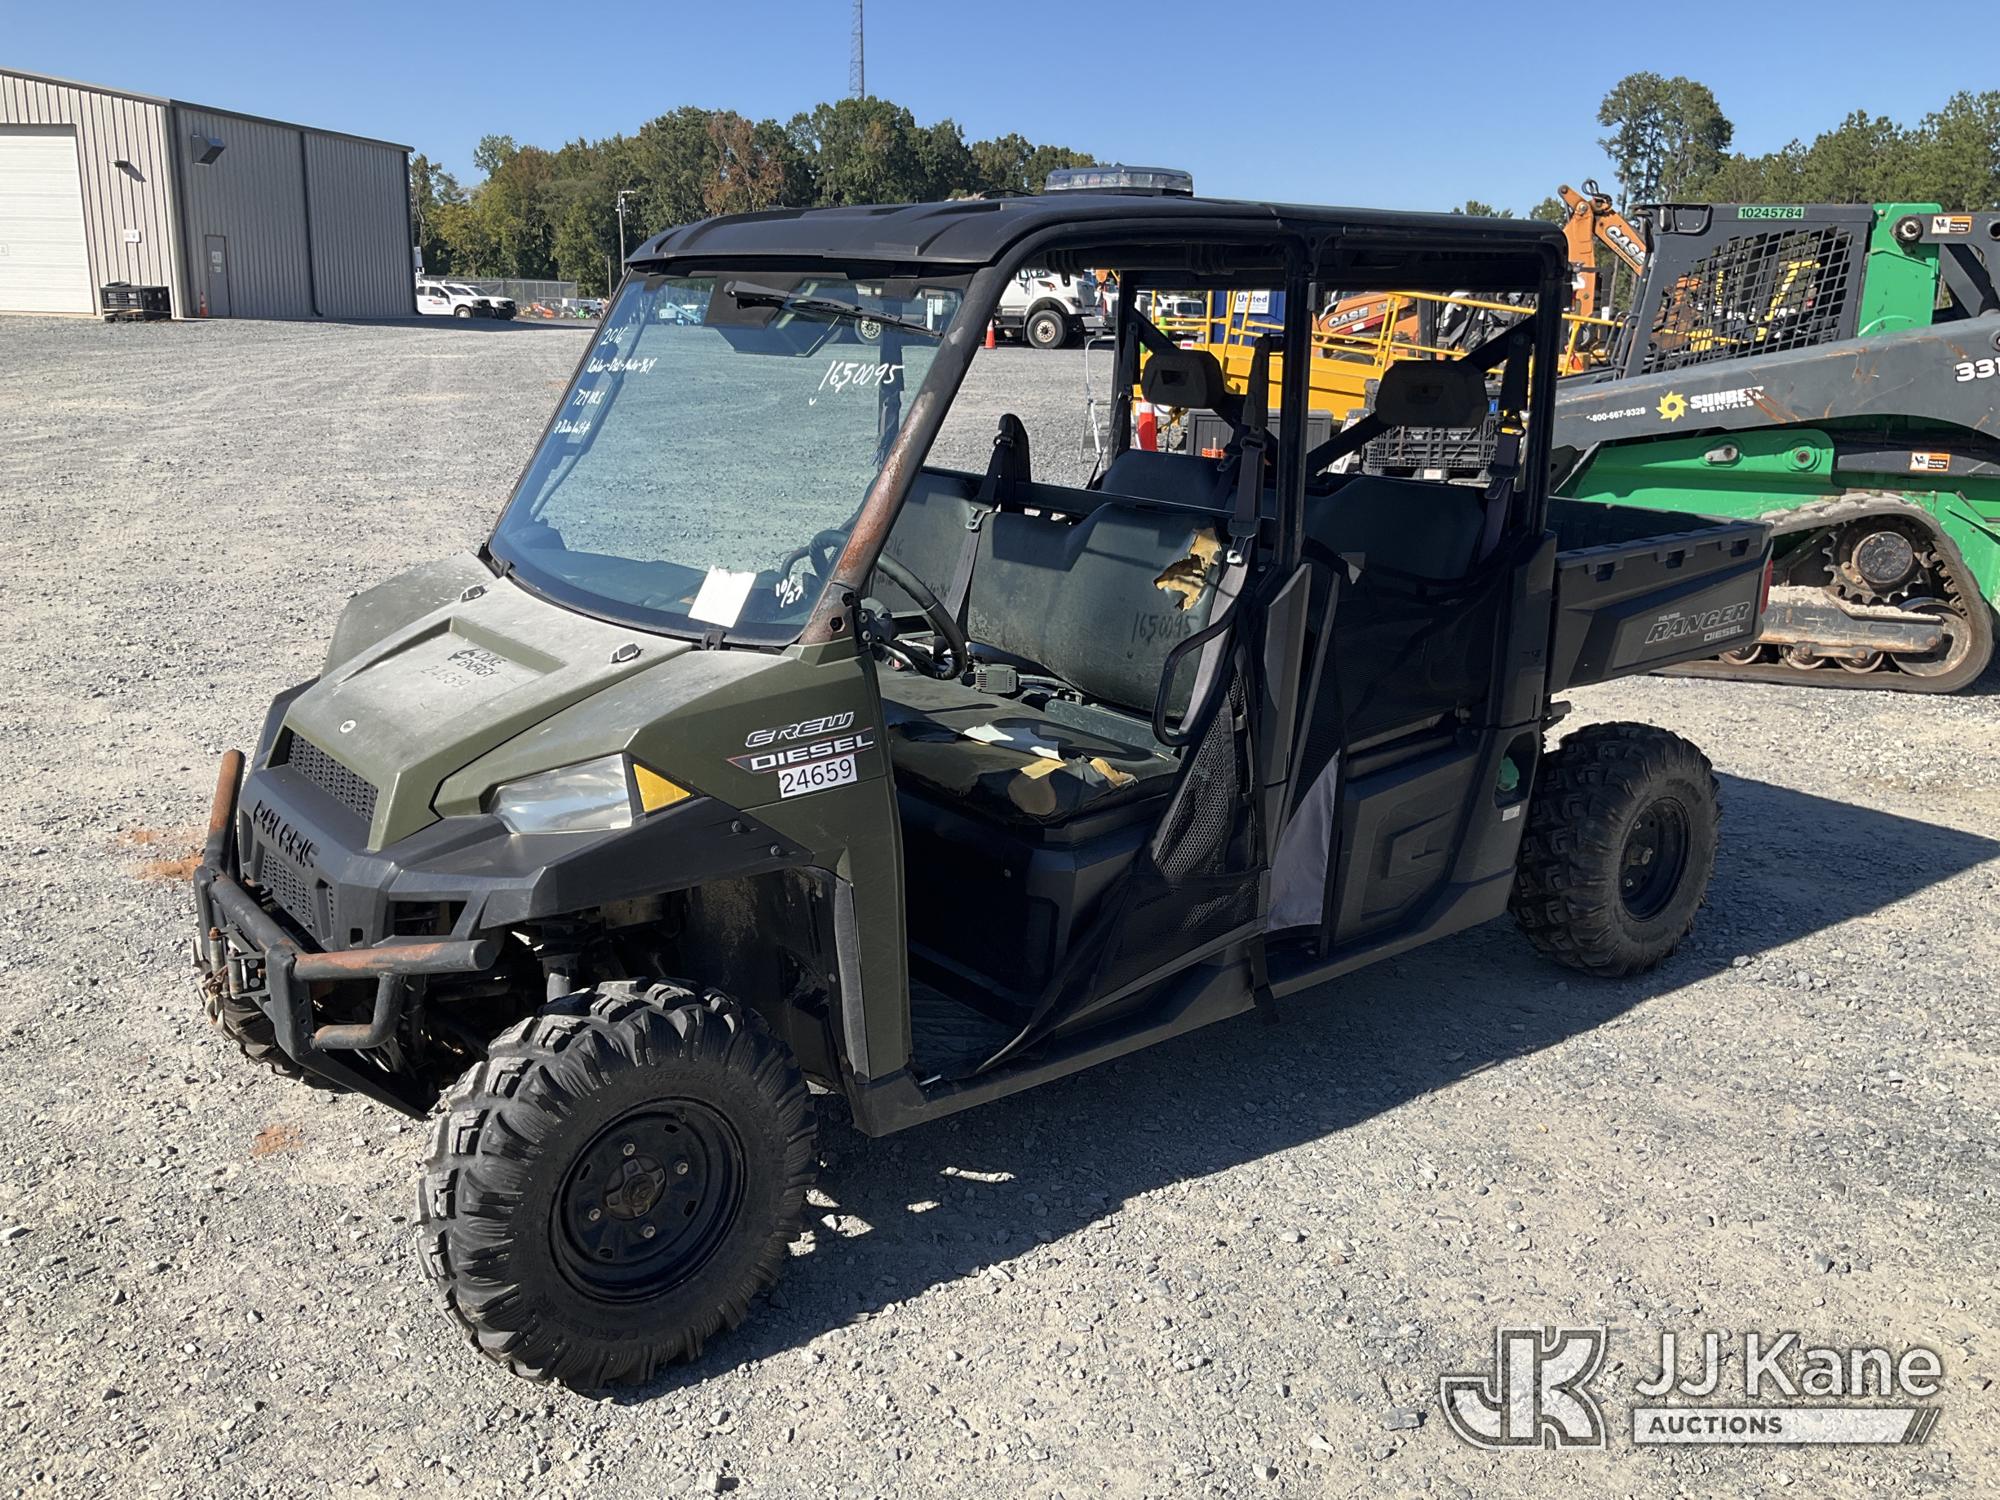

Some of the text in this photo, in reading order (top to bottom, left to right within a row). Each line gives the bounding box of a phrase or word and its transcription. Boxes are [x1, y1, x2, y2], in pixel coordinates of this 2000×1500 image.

[1741, 207, 1803, 219] 10245784
[1237, 294, 1268, 303] Unted
[1328, 304, 1369, 329] CASE
[817, 359, 906, 394] 1650095
[1701, 400, 1754, 413] RENTALS
[1131, 609, 1200, 646] 1650095
[1644, 601, 1751, 645] RANGER
[1703, 625, 1744, 642] DIESEL
[745, 711, 855, 748] CREW
[750, 735, 875, 771] DIESEL
[781, 758, 852, 794] 24659
